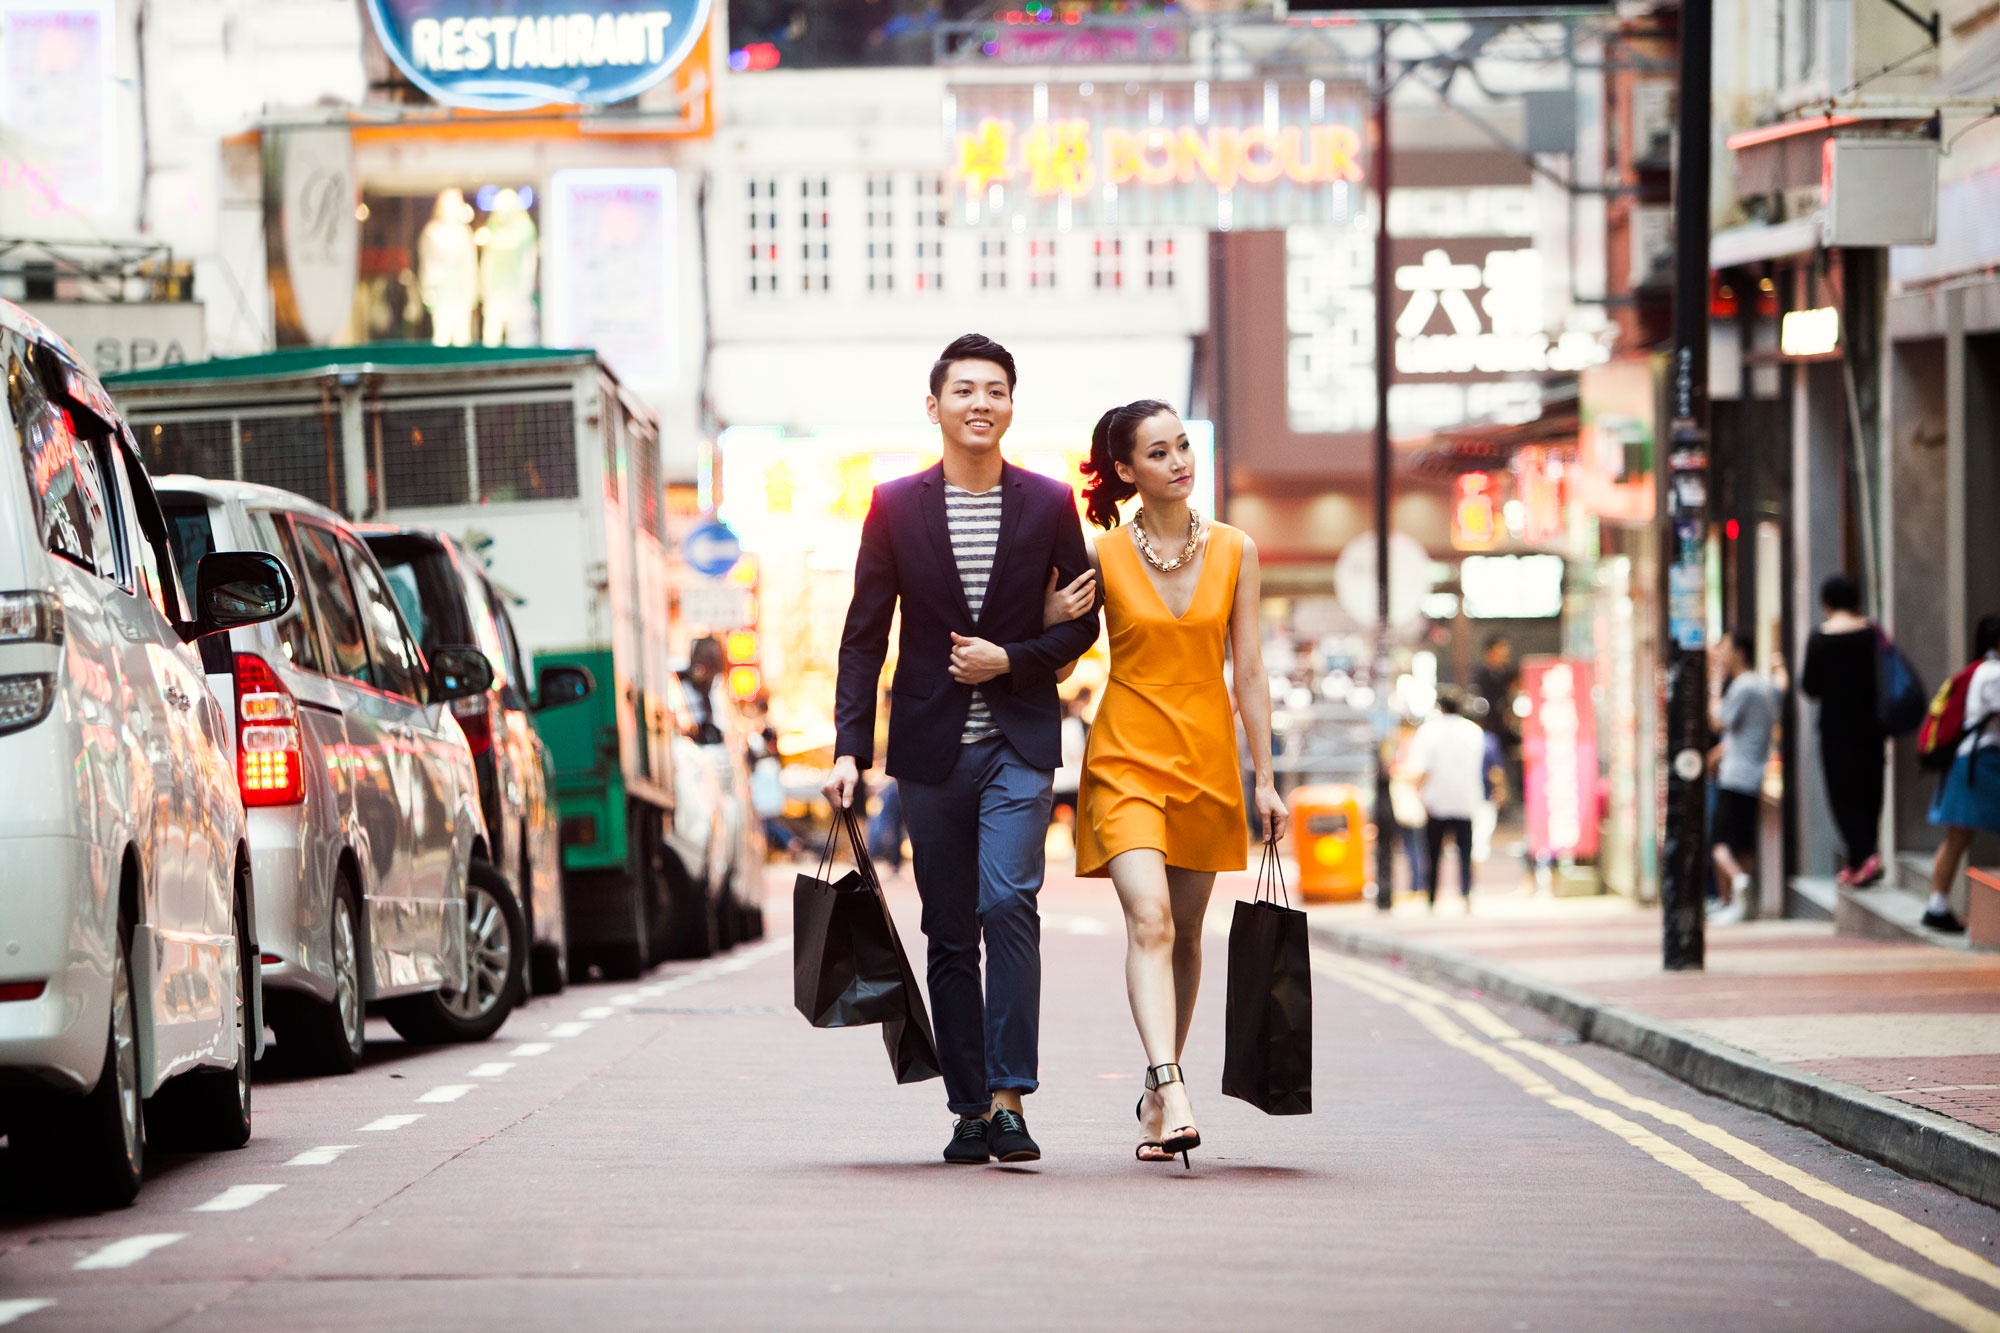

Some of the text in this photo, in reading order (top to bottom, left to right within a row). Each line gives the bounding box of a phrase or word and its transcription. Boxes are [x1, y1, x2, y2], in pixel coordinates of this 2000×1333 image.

[411, 12, 672, 72] RESTAURANT
[1102, 124, 1365, 192] BONJOUR
[95, 336, 186, 377] SPA
